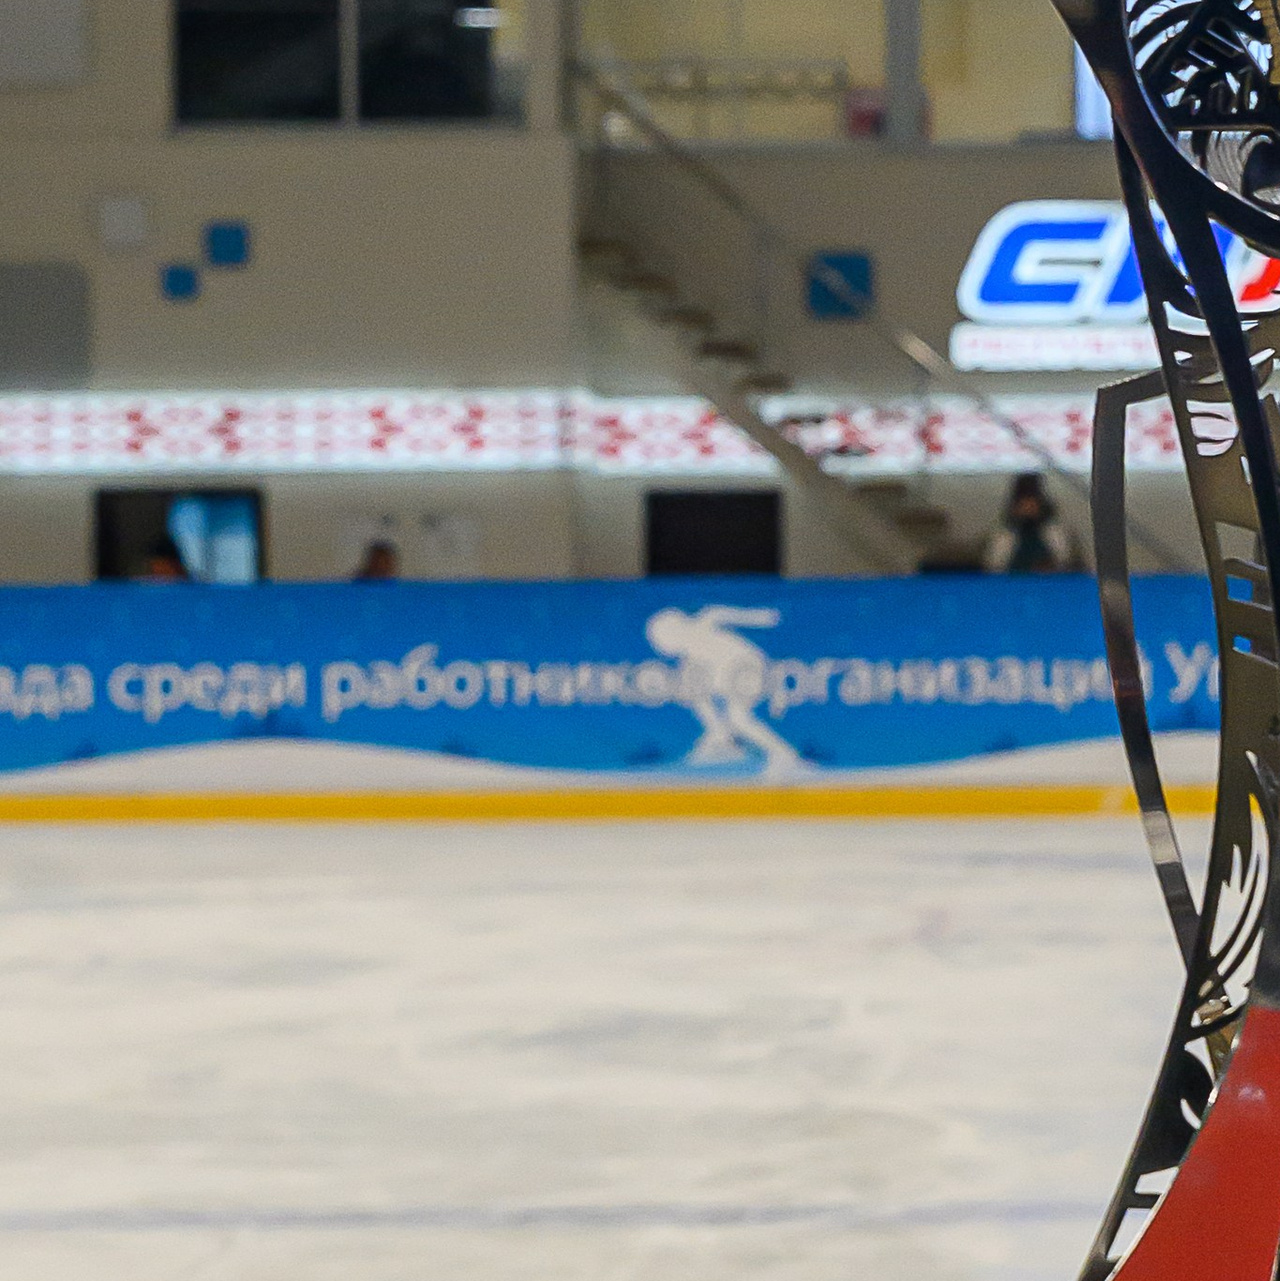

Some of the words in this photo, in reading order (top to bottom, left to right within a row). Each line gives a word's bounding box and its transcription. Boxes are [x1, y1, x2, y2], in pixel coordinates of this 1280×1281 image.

[107, 662, 307, 722] среди
[321, 643, 714, 722] работнико
[730, 655, 1152, 719] рганизаци
